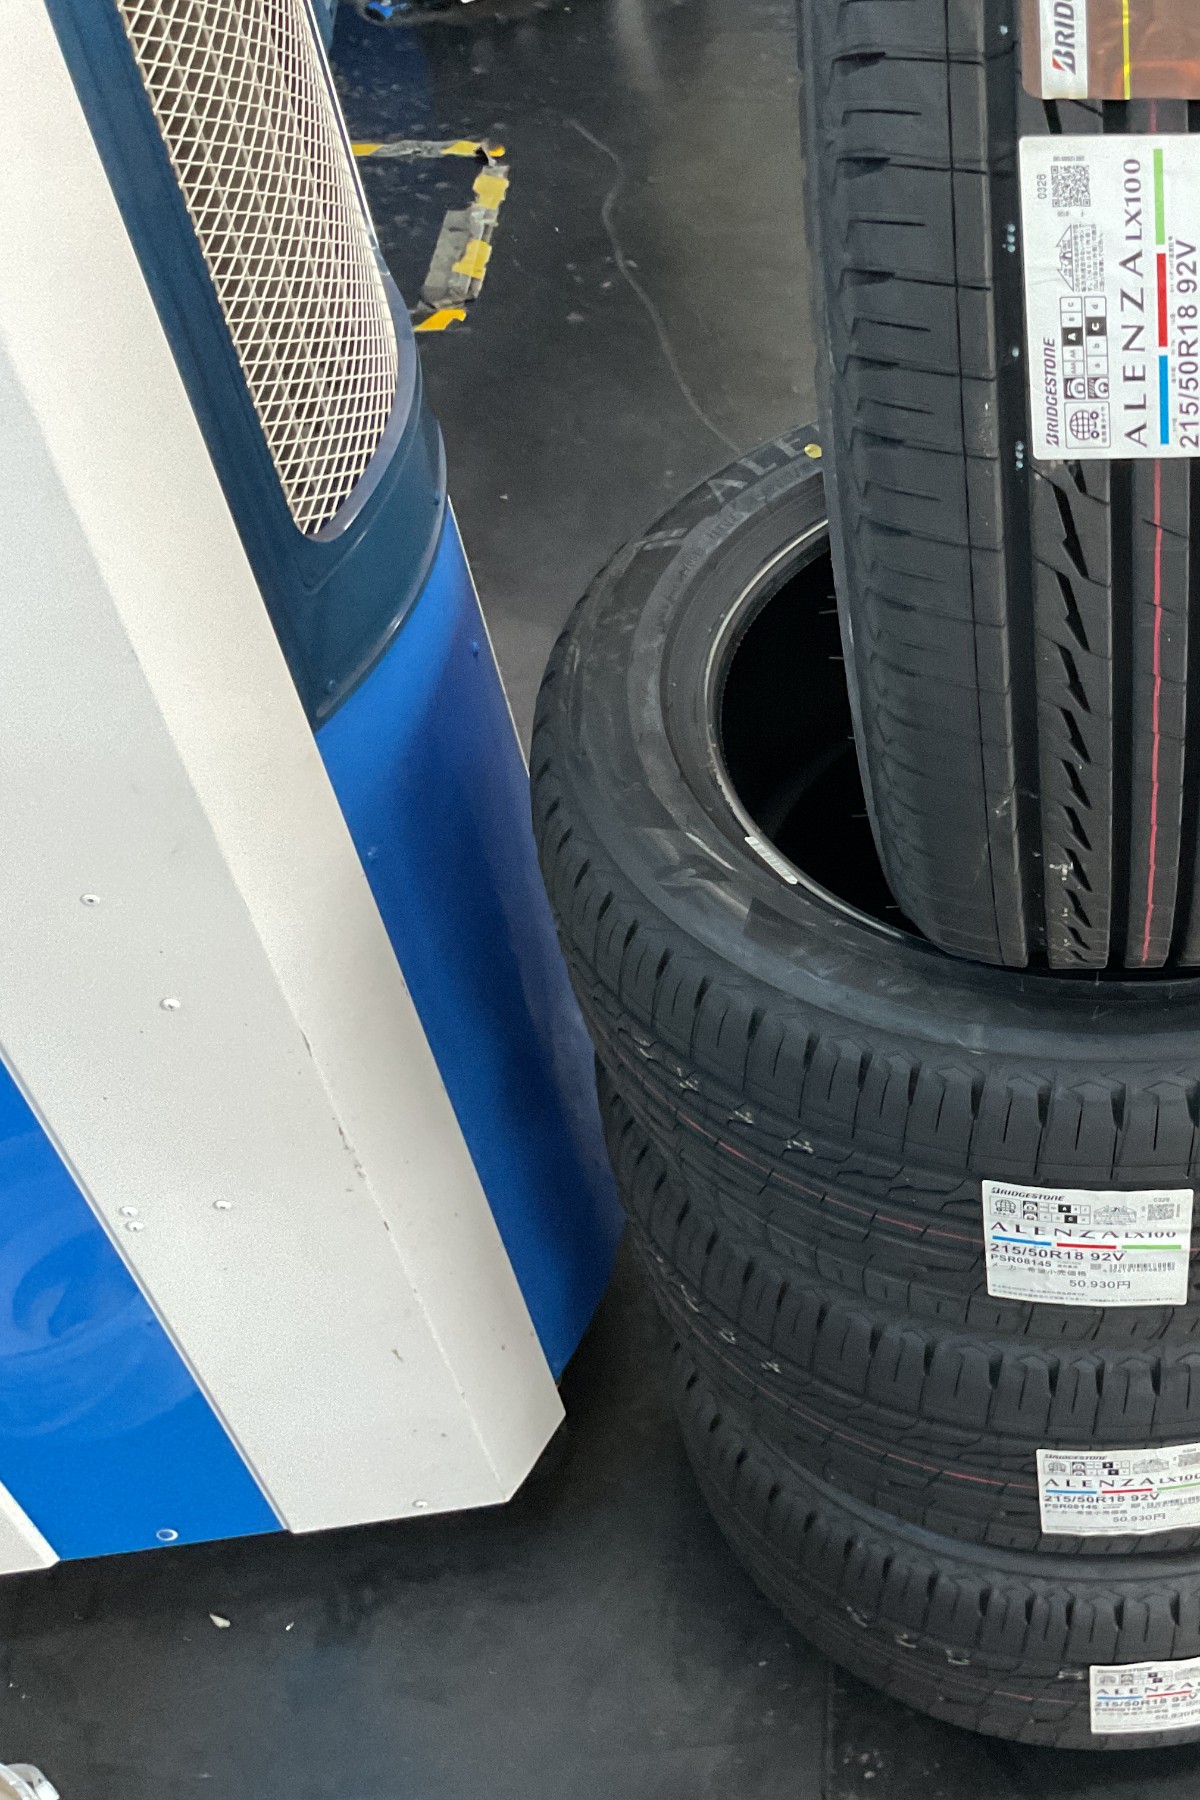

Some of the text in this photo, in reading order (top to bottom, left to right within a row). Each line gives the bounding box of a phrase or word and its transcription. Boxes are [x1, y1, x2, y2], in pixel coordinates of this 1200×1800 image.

[1052, 0, 1076, 75] BRID
[1118, 158, 1148, 448] ALENZA LX100
[1068, 332, 1076, 341] A
[1175, 239, 1200, 449] 215/50R18 92V
[1042, 337, 1060, 448] BRIDGESTONE
[708, 426, 818, 502] ALE
[991, 1187, 1065, 1201] BRIDGESTONE
[990, 1221, 1176, 1240] ALENZA LX100
[990, 1243, 1125, 1261] 215/50R18 92V
[990, 1254, 1052, 1268] PSR08145
[992, 1262, 1086, 1276] メーカー希望小売価格
[1045, 1477, 1155, 1488] ALENZA
[1044, 1492, 1160, 1503] 215/50R18 92V
[1096, 1682, 1194, 1694] ALENZA
